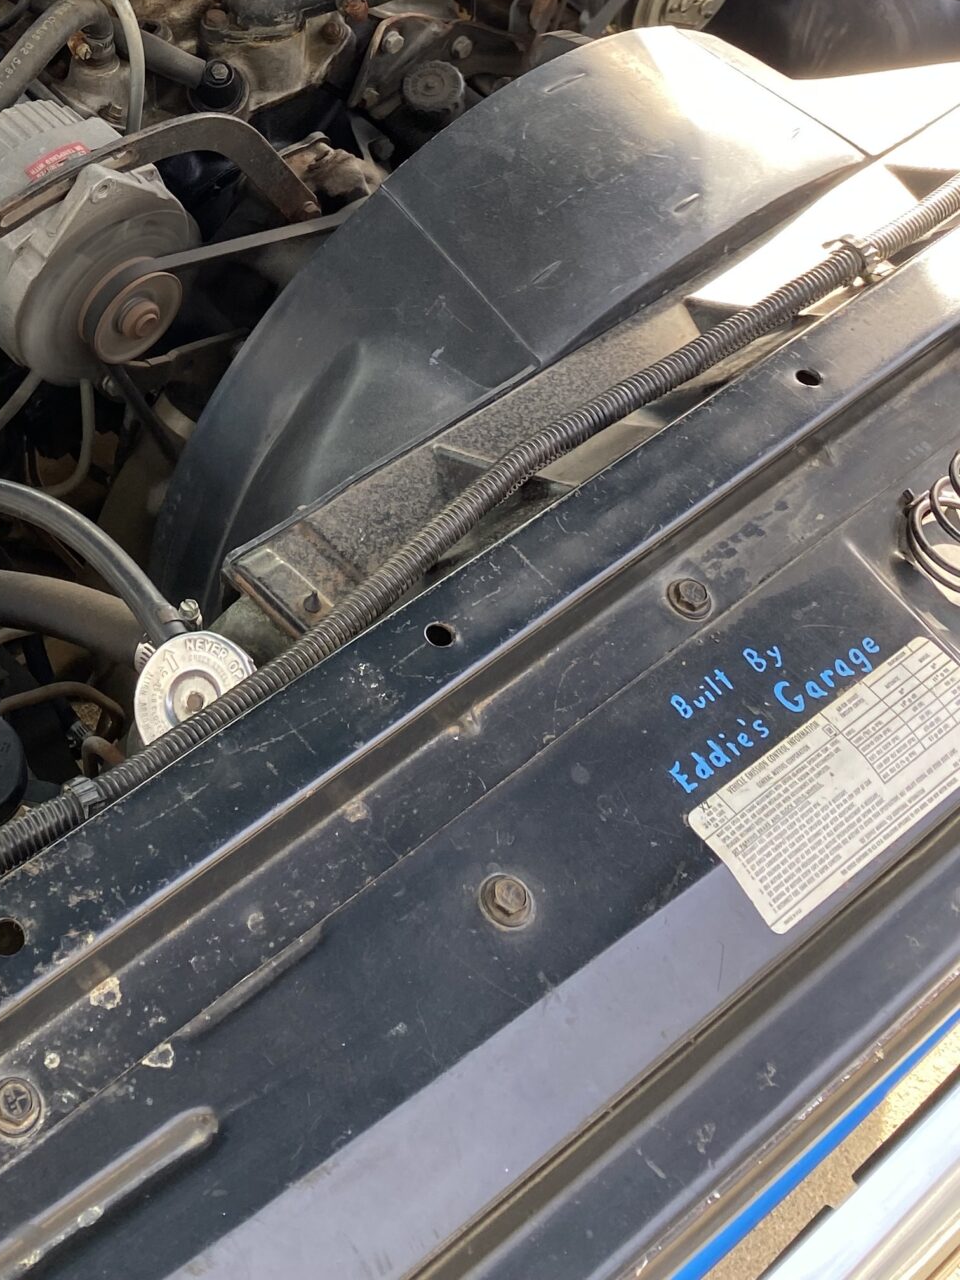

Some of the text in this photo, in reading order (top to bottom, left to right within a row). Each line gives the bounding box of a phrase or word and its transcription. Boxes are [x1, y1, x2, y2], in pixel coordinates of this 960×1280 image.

[184, 638, 229, 664] NEVER
[670, 645, 783, 719] Built By
[668, 718, 770, 793] Eddie's
[774, 636, 880, 712] Garage
[766, 742, 790, 763] CONTROL
